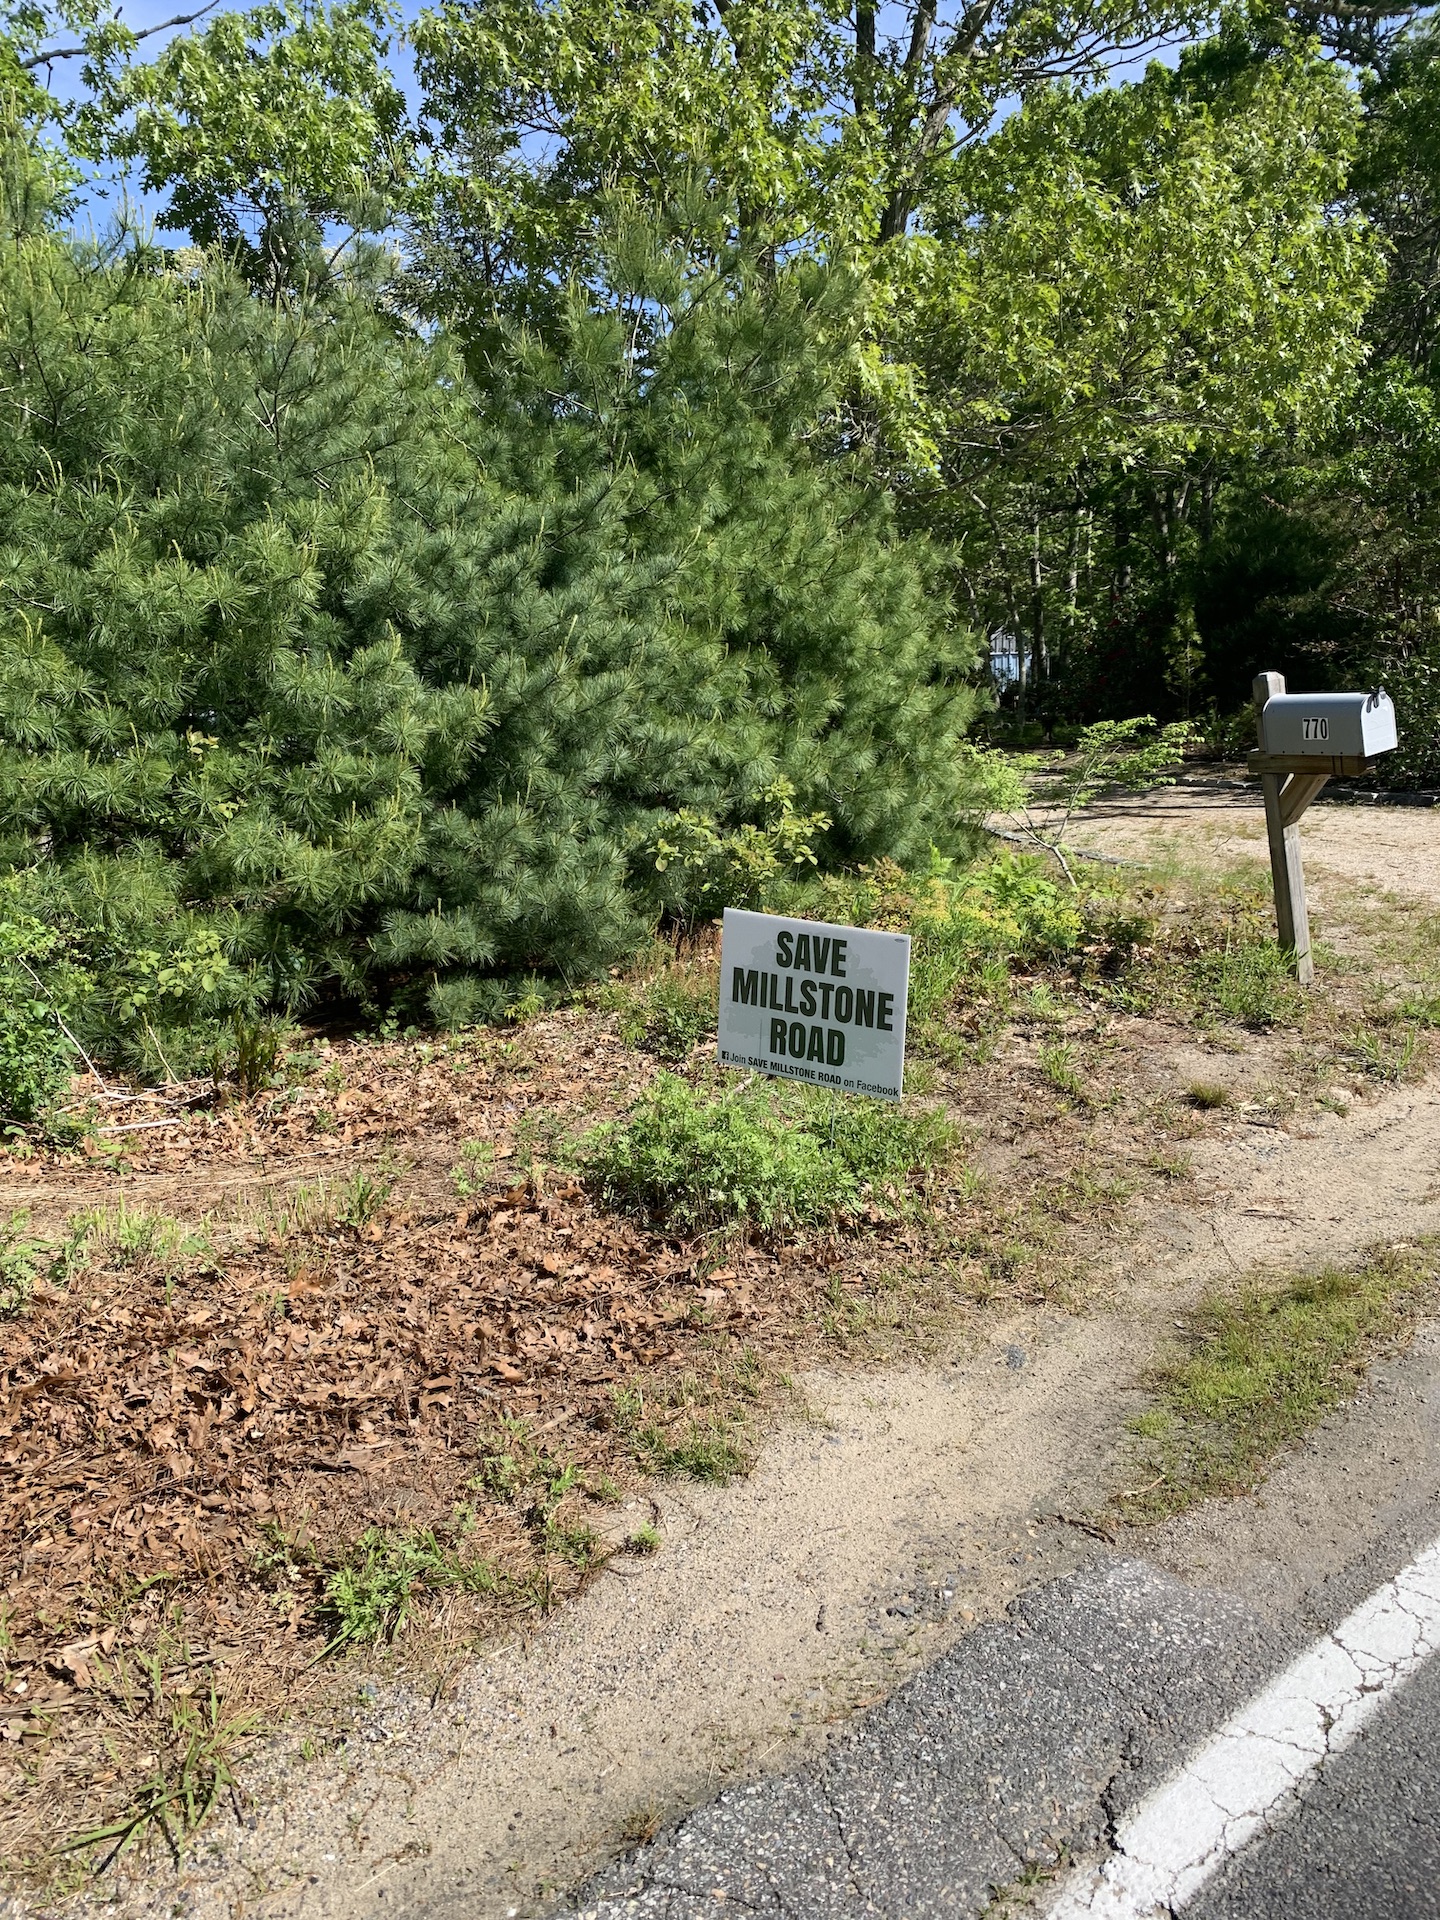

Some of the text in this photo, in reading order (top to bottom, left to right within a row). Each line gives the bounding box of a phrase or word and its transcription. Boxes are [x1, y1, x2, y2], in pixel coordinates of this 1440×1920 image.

[1303, 718, 1328, 739] 770
[776, 930, 848, 977] SAVE
[732, 966, 894, 1032] MILLSTONE
[769, 1017, 846, 1067] ROAD
[730, 1052, 746, 1065] Join
[747, 1056, 768, 1070] SAVE
[770, 1061, 816, 1080] MILLSTONE
[818, 1071, 841, 1085] ROAD
[843, 1078, 855, 1088] on
[856, 1079, 899, 1097] Facebook
